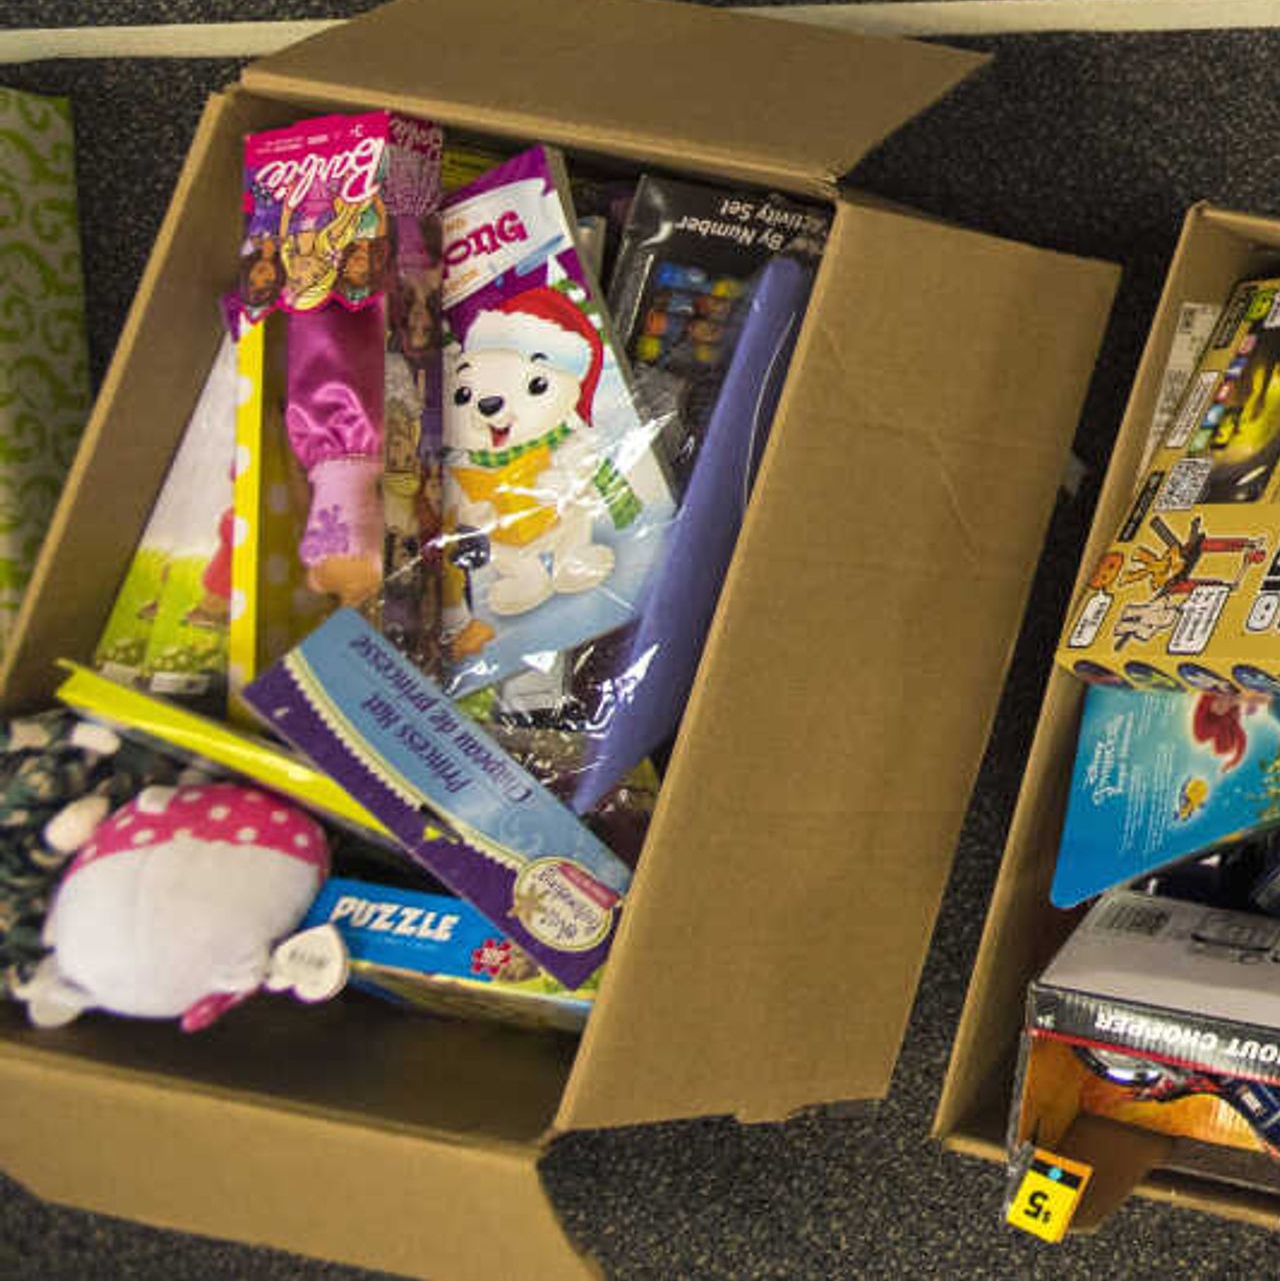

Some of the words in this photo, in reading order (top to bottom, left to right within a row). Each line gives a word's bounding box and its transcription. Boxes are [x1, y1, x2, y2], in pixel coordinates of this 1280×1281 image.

[254, 137, 387, 209] Barbie
[719, 198, 755, 220] Set
[674, 215, 754, 246] Number
[758, 228, 784, 250] By
[361, 695, 406, 733] Hat
[401, 726, 471, 795] Princess
[330, 895, 461, 944] PUZZLE
[1093, 1011, 1220, 1056] CHOPPER
